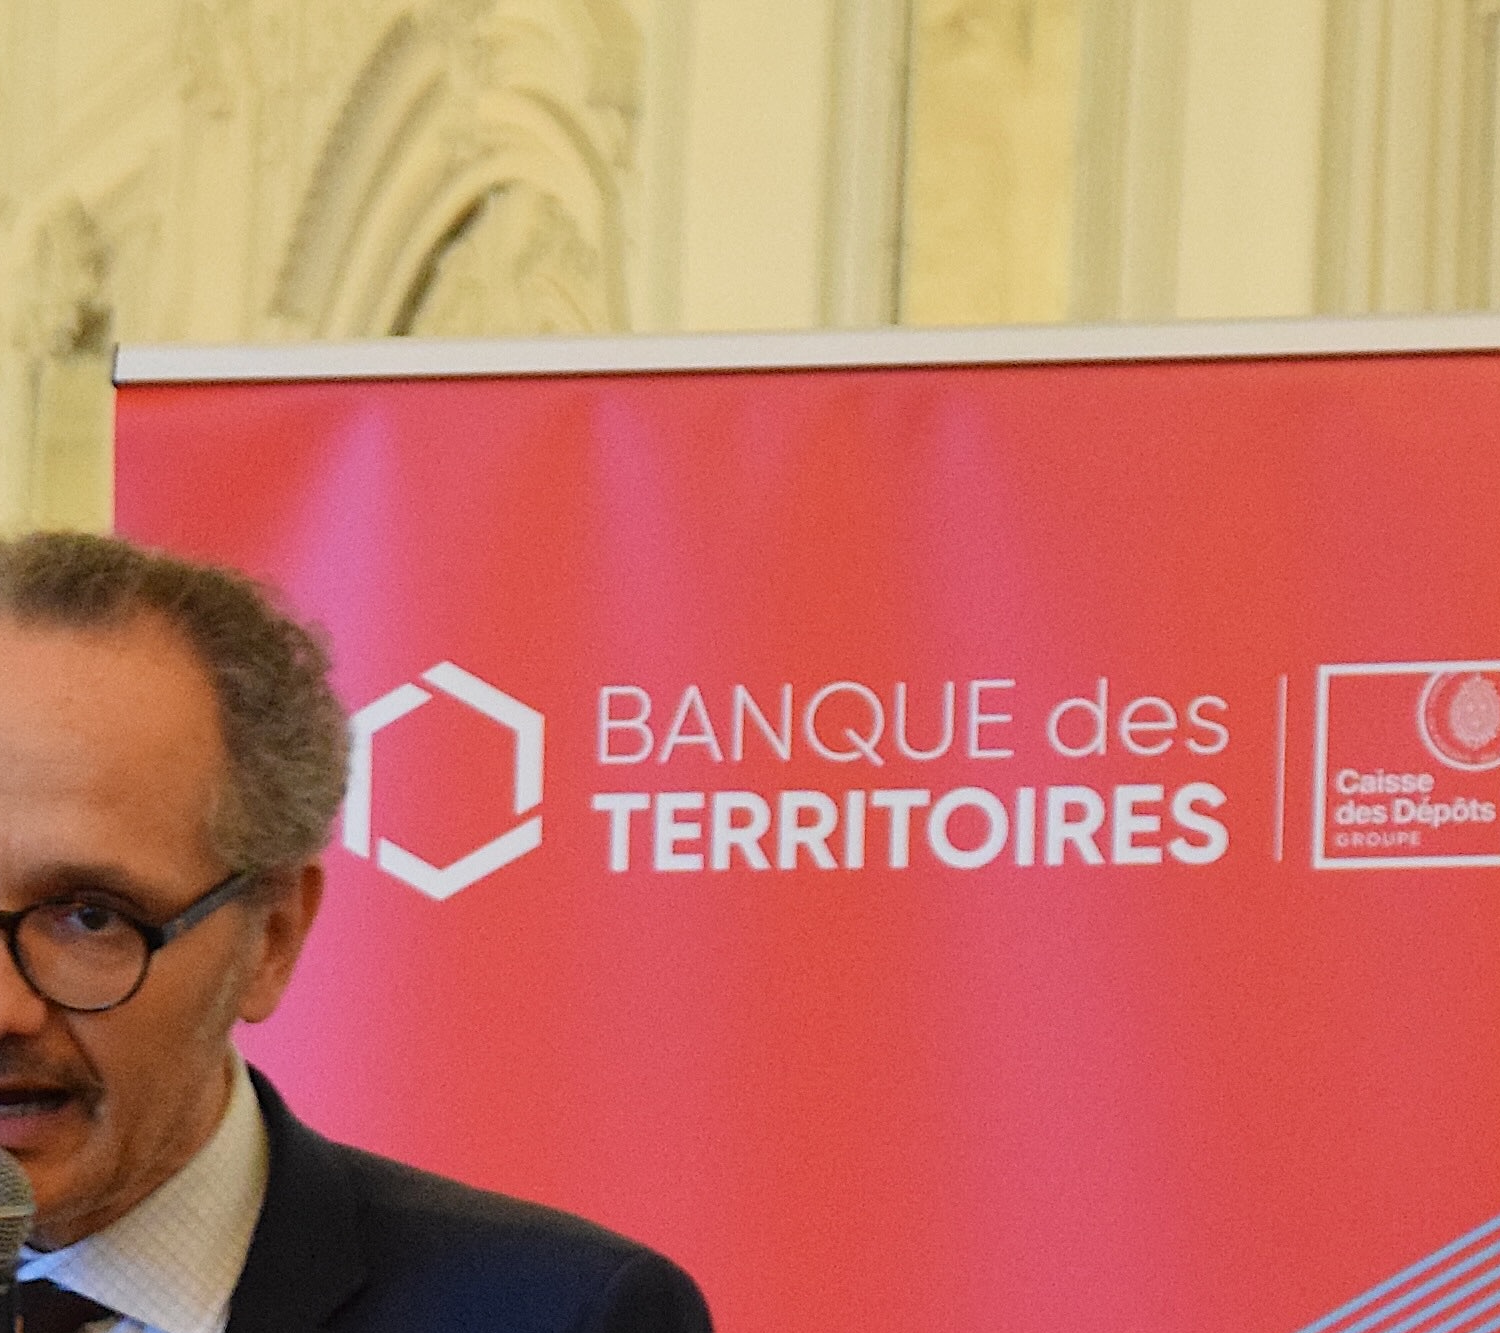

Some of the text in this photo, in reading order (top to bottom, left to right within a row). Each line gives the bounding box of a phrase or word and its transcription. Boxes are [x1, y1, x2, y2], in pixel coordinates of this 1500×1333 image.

[600, 677, 1230, 766] BANQUE des
[1336, 768, 1435, 795] Caisse
[593, 782, 1228, 873] TERRITOIRES
[1335, 795, 1497, 829] des Dépôts
[1335, 831, 1421, 848] GROUPE
